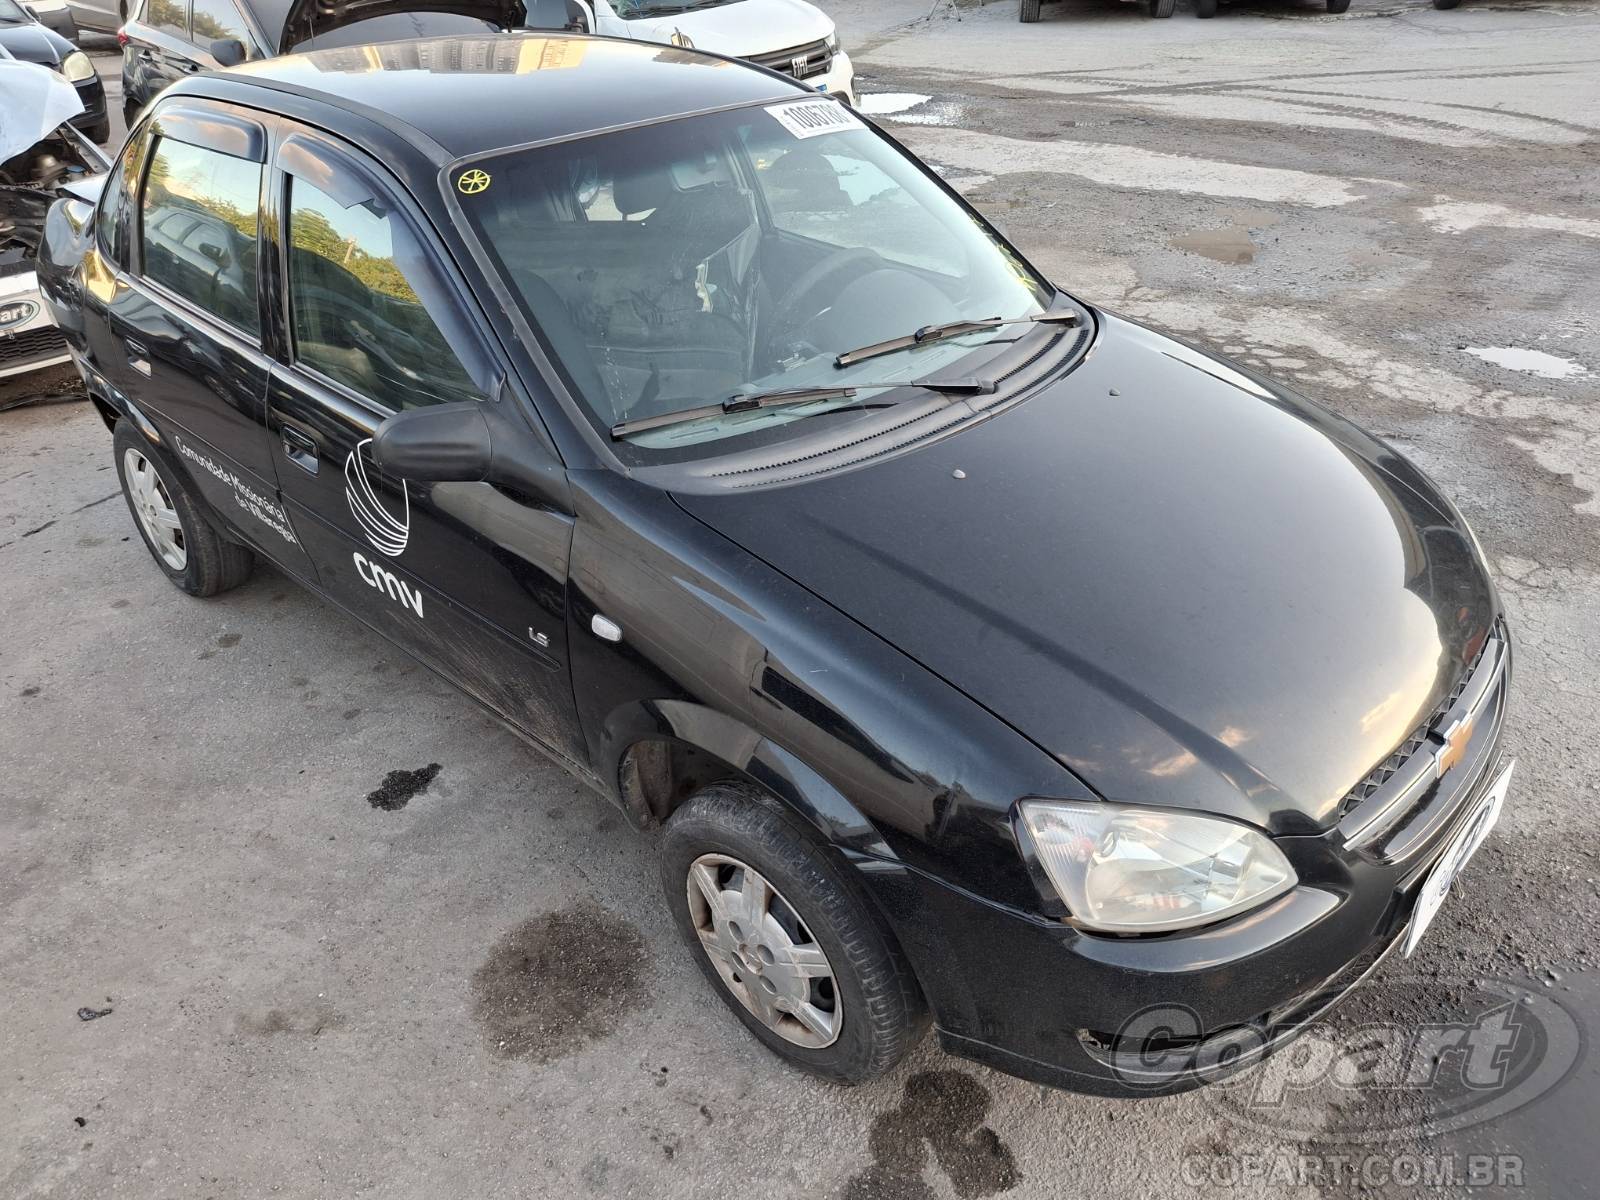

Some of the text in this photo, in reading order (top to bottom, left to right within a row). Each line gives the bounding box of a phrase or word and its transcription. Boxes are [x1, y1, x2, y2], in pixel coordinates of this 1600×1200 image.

[175, 435, 286, 523] Comunidade Missionária
[234, 491, 250, 511] de
[353, 552, 424, 618] cmv
[528, 626, 550, 648] LS
